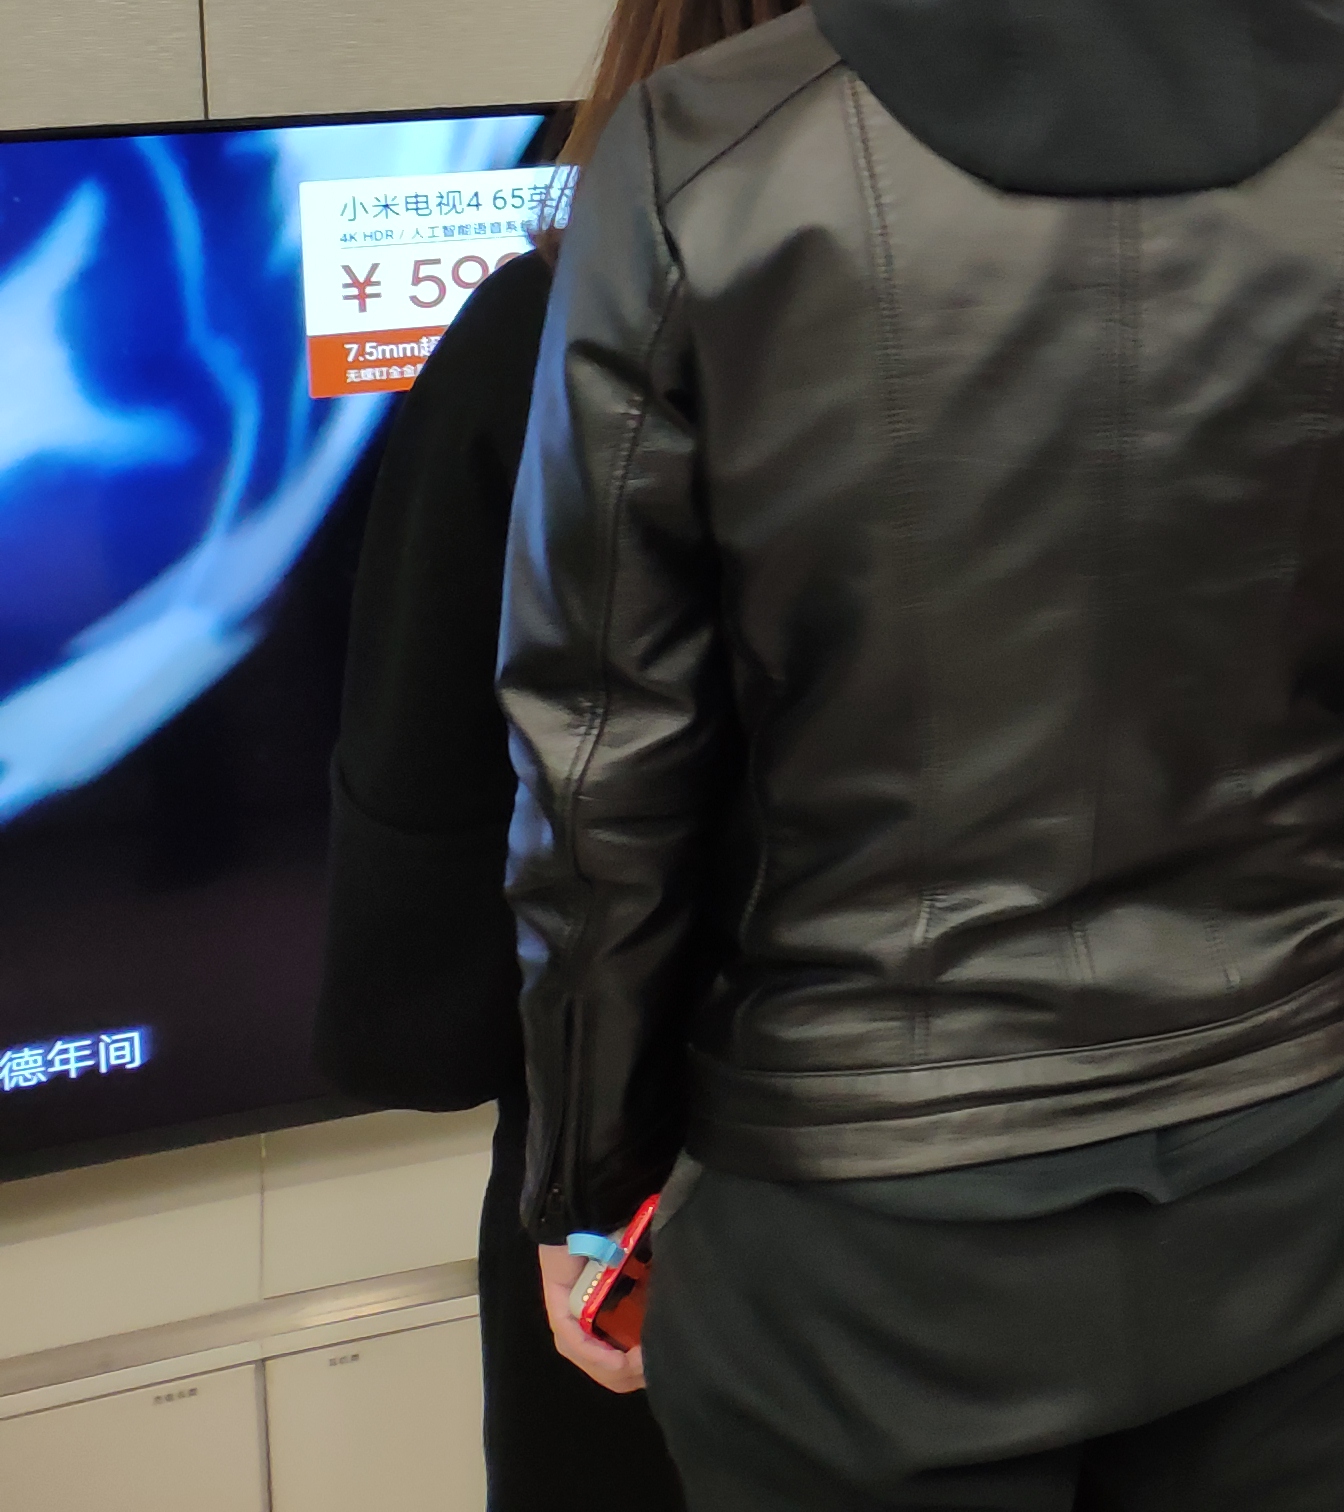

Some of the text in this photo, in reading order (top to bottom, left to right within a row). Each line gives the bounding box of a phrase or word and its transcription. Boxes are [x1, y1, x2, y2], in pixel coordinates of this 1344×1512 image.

[340, 191, 483, 222] 小米电视4
[363, 229, 394, 242] HDR
[408, 252, 522, 309] 59
[0, 1031, 142, 1091] 德年间
